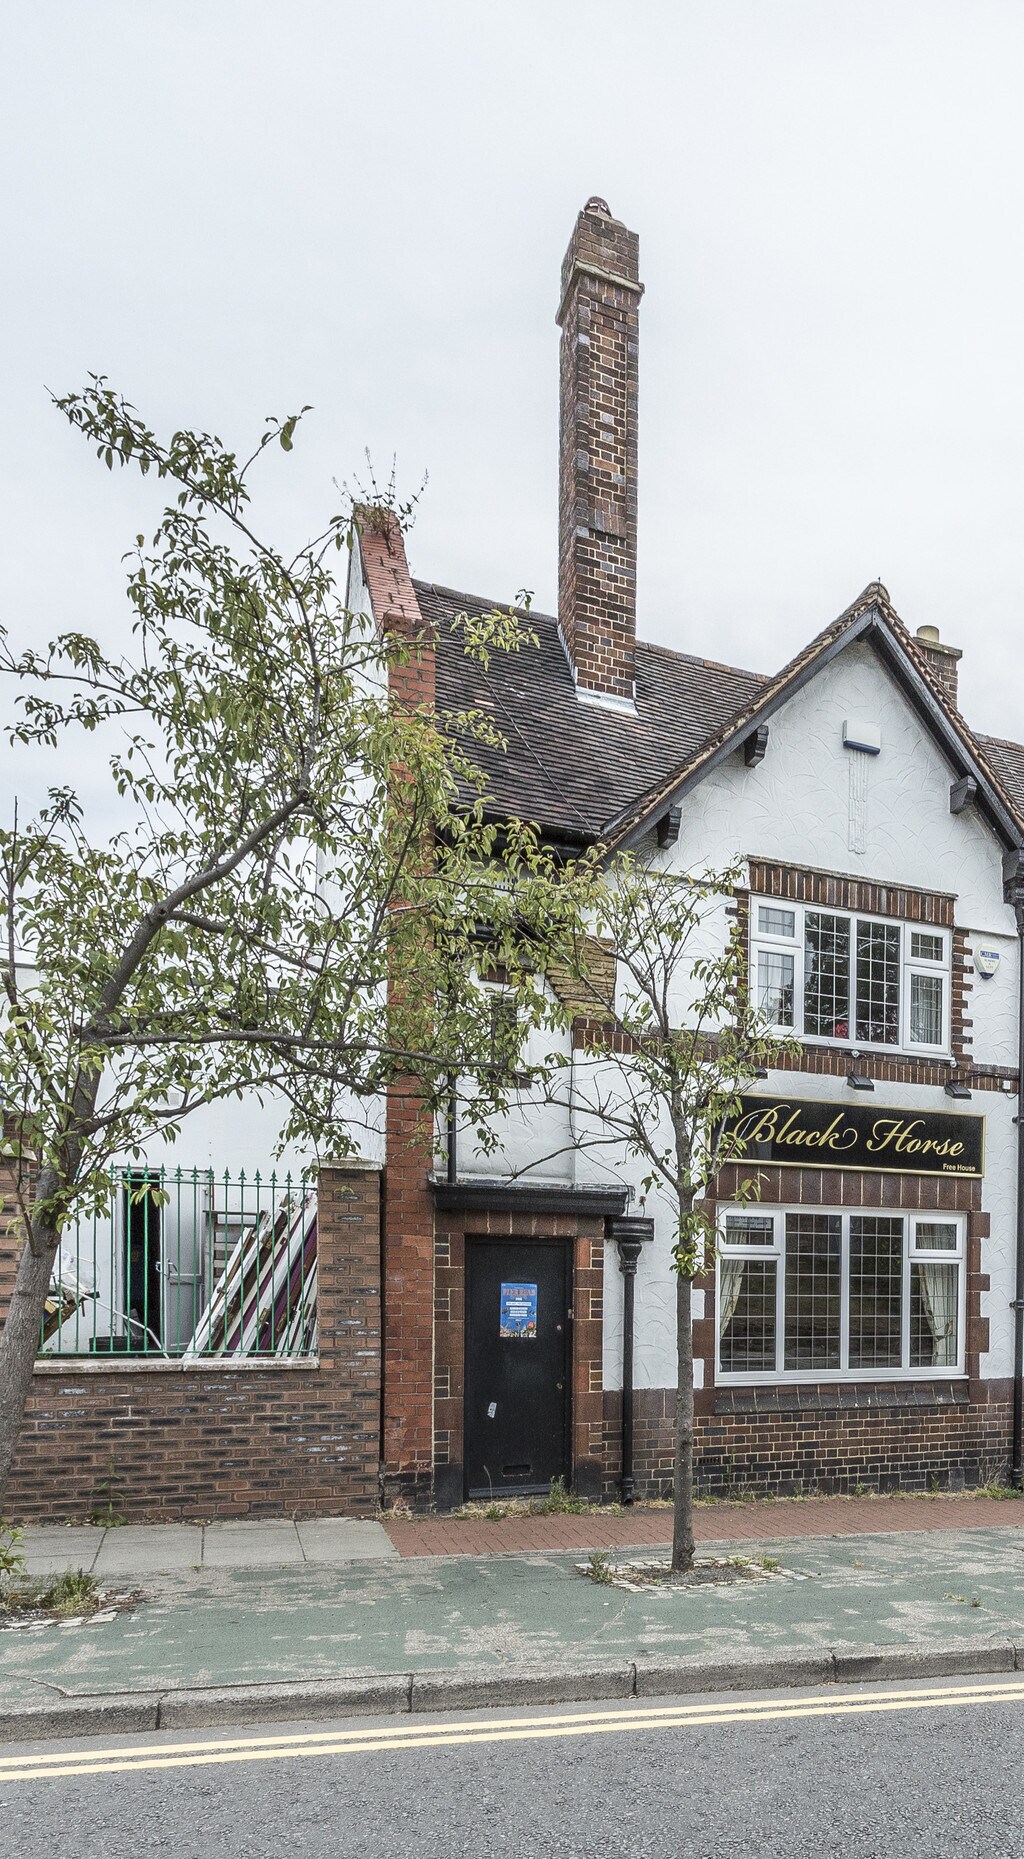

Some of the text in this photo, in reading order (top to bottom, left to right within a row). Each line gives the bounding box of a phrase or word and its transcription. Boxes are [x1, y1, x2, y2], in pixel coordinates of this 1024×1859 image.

[734, 1104, 965, 1157] Black Horse
[957, 1164, 976, 1172] House
